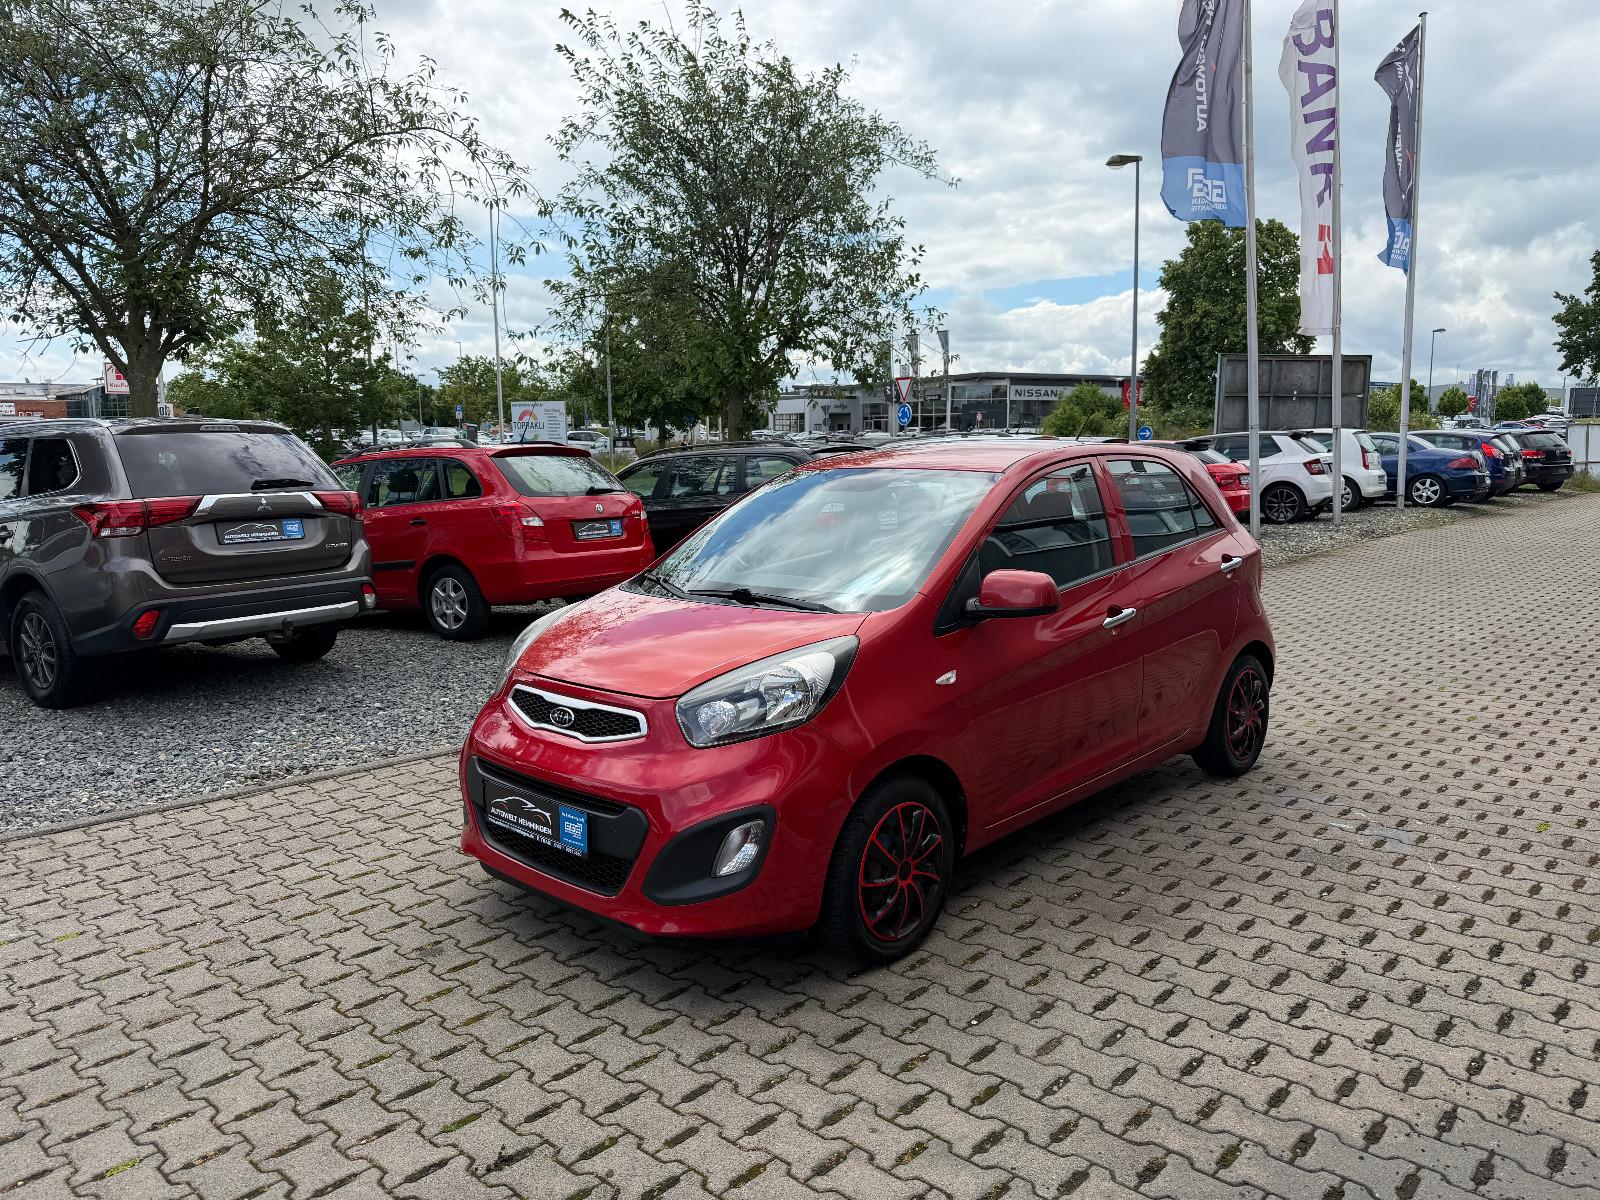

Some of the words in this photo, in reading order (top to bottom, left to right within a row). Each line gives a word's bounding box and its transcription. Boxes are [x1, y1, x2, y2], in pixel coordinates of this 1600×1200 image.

[1014, 388, 1059, 398] NISSAN
[512, 421, 545, 430] TOPRAKLI
[553, 710, 570, 724] KIA
[490, 806, 517, 823] AUTOWELT
[518, 816, 553, 836] HEMMINGEN
